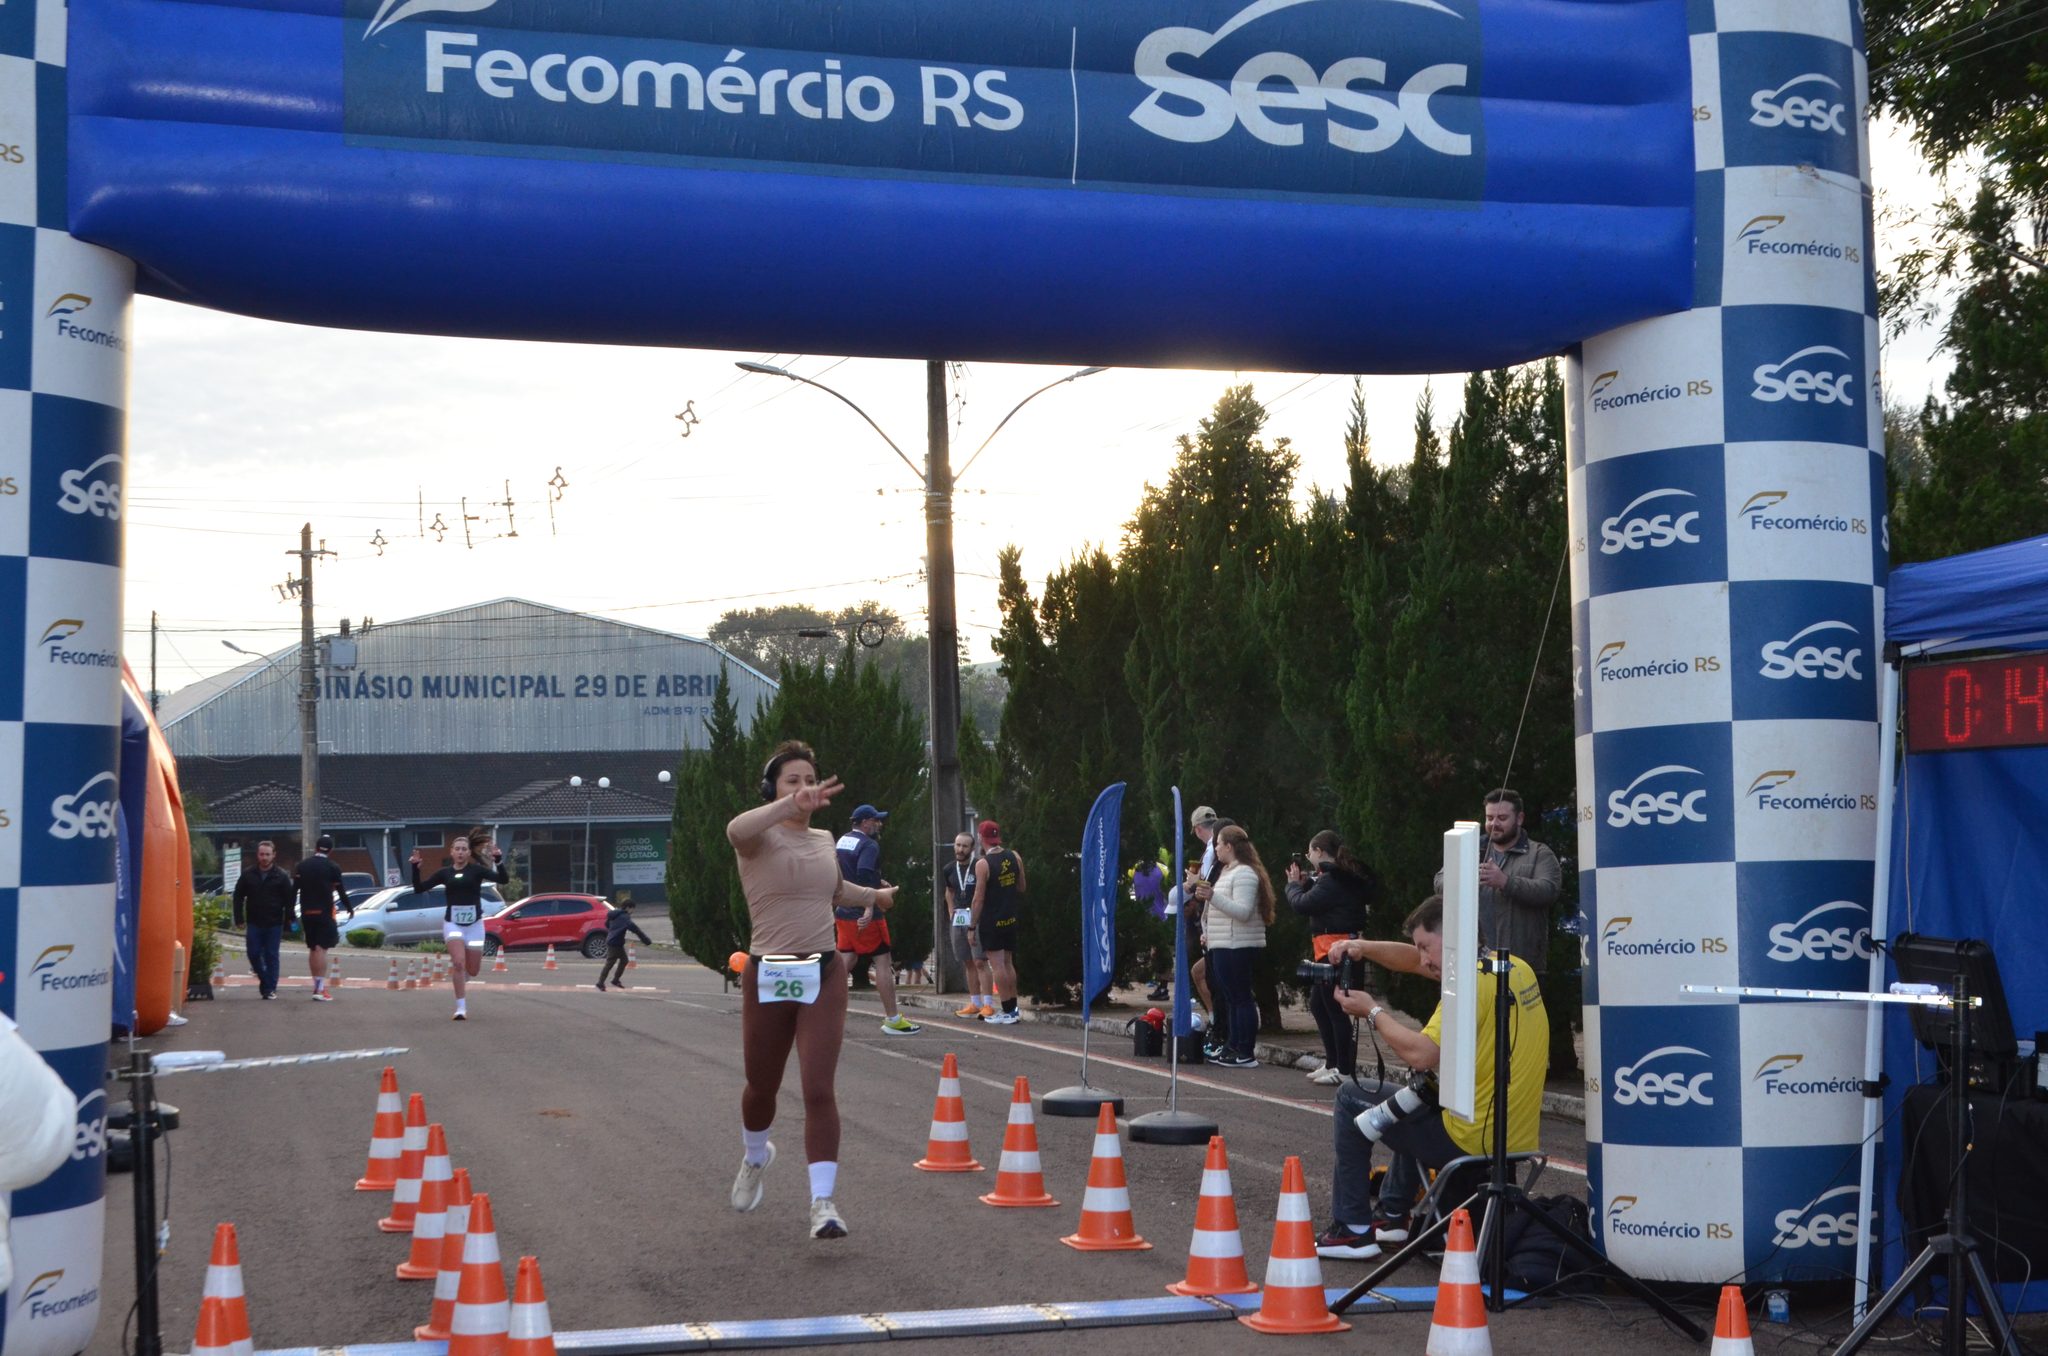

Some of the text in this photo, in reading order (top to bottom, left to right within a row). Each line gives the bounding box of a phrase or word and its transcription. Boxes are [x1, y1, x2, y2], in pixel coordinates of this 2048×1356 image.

[425, 30, 1024, 131] Fecomércio RS
[1129, 26, 1471, 155] Sesc
[1749, 88, 1846, 136] Sesc
[1748, 239, 1859, 263] Fecomércio RS
[1594, 379, 1712, 412] Fecomércio RS
[1751, 364, 1853, 406] Sesc
[56, 469, 122, 520] Ses
[1600, 511, 1699, 555] Sesc
[1751, 515, 1847, 531] Fecomércio
[1852, 518, 1867, 534] RS
[1601, 659, 1688, 682] Fecomércio
[1694, 656, 1720, 672] RS
[1759, 640, 1862, 680] Sesc
[422, 675, 565, 698] MUNICIPAL
[575, 674, 607, 697] 29
[615, 675, 647, 697] DE
[643, 706, 669, 716] ADM
[1607, 789, 1707, 828] Sesc
[1759, 793, 1875, 811] Fecomércio RS
[629, 851, 659, 859] ESTADO
[455, 912, 473, 922] 172
[955, 915, 966, 925] 40
[1607, 939, 1695, 956] Fecomércio
[1702, 938, 1728, 954] RS
[774, 980, 804, 998] 26
[1613, 1066, 1713, 1106] Sesc
[1613, 1219, 1700, 1238] Fecomércio
[1707, 1223, 1733, 1239] RS
